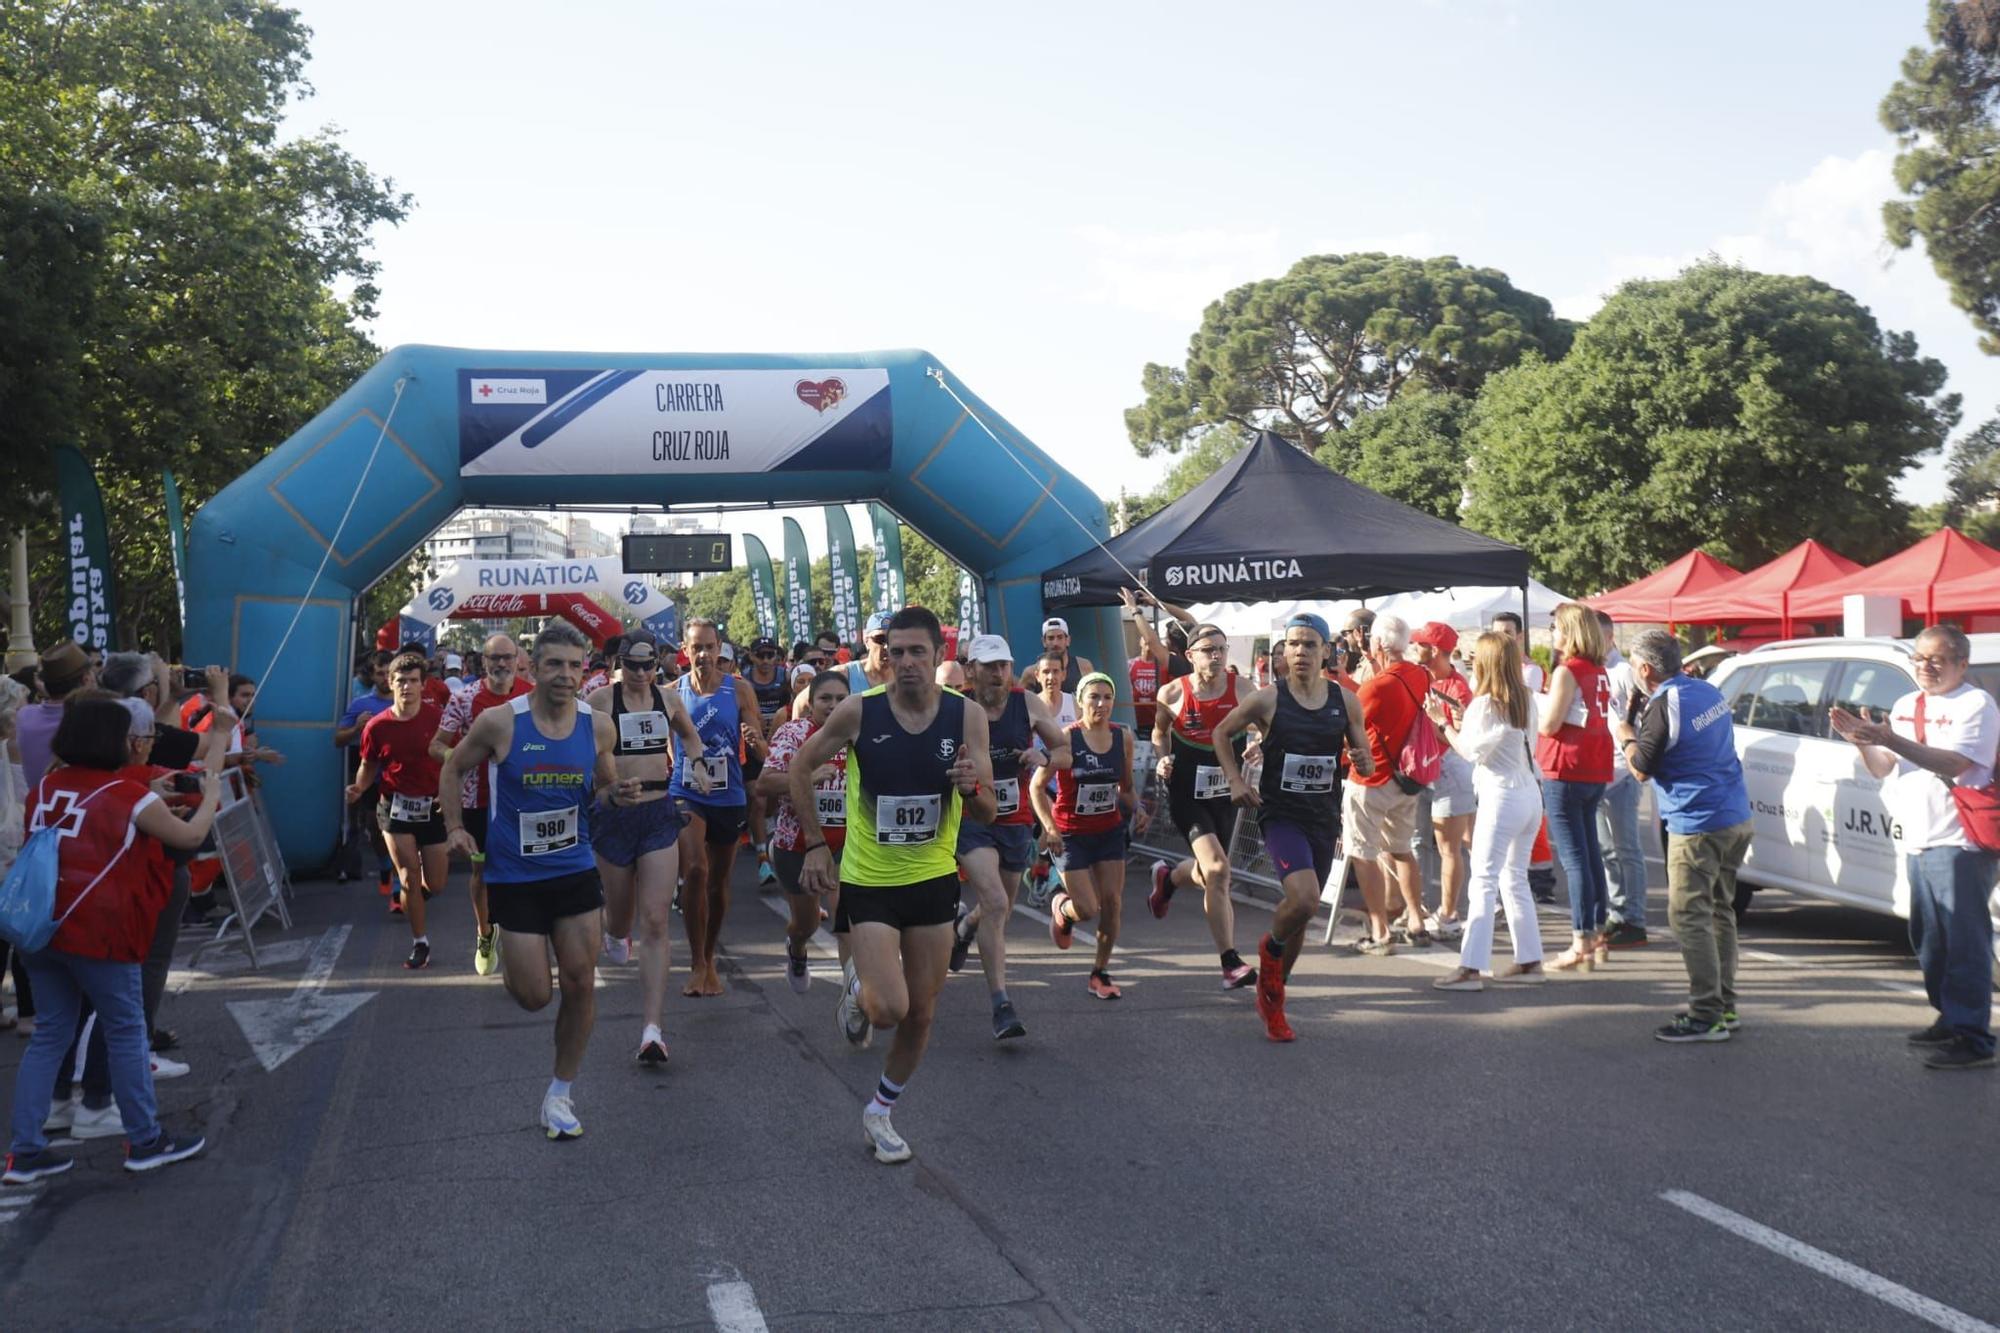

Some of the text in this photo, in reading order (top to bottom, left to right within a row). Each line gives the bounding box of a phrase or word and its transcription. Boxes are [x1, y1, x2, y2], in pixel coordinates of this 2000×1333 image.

[497, 386, 540, 396] Cruz Roja
[656, 383, 724, 412] CARRERA
[652, 430, 729, 461] CRUZ ROJA
[478, 563, 599, 587] RUNÁTICA
[1185, 556, 1304, 585] RUNÁTICA
[638, 720, 653, 734] 15
[523, 772, 584, 785] runners
[1297, 765, 1324, 779] 493
[819, 799, 842, 813] 506
[1756, 801, 1778, 816] Cruz
[896, 807, 926, 826] 812
[1844, 807, 1903, 840] J.R. Va
[536, 819, 566, 838] 980
